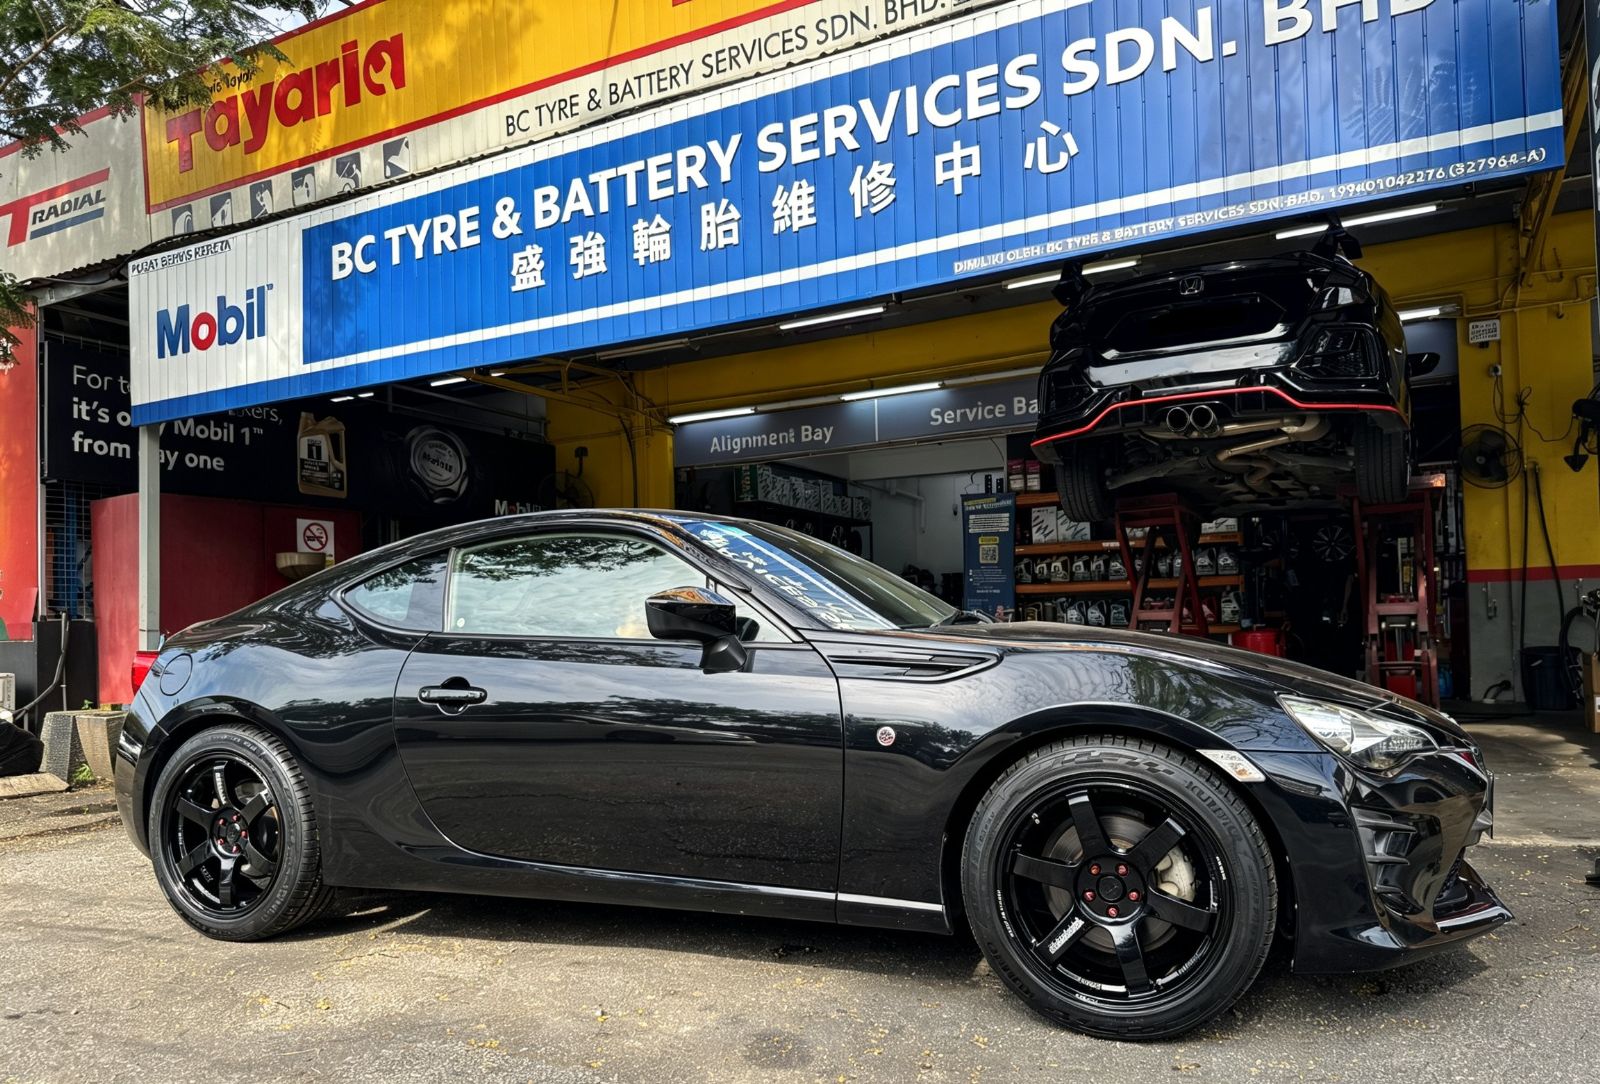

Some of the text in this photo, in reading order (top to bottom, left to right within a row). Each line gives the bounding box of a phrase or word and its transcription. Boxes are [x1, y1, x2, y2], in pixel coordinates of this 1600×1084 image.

[505, 114, 530, 137] BC
[535, 88, 580, 128] TYRE
[587, 88, 602, 110] &
[608, 59, 694, 107] BATTERY
[701, 25, 809, 78] SERVICES
[816, 4, 878, 45] SDN.
[166, 32, 406, 174] Tayaria
[332, 235, 377, 281] BC
[384, 205, 481, 266] TYRE
[491, 196, 523, 240] &
[533, 133, 743, 230] BATTERY
[756, 53, 1042, 173] SERVICES
[1061, 16, 1237, 96] SDN.
[32, 190, 106, 225] RADIAL
[73, 365, 113, 391] For
[930, 396, 1038, 426] Service Ba
[174, 417, 235, 443] Mobil
[710, 425, 834, 454] Alignment Bay
[72, 430, 131, 459] from
[184, 452, 225, 471] one
